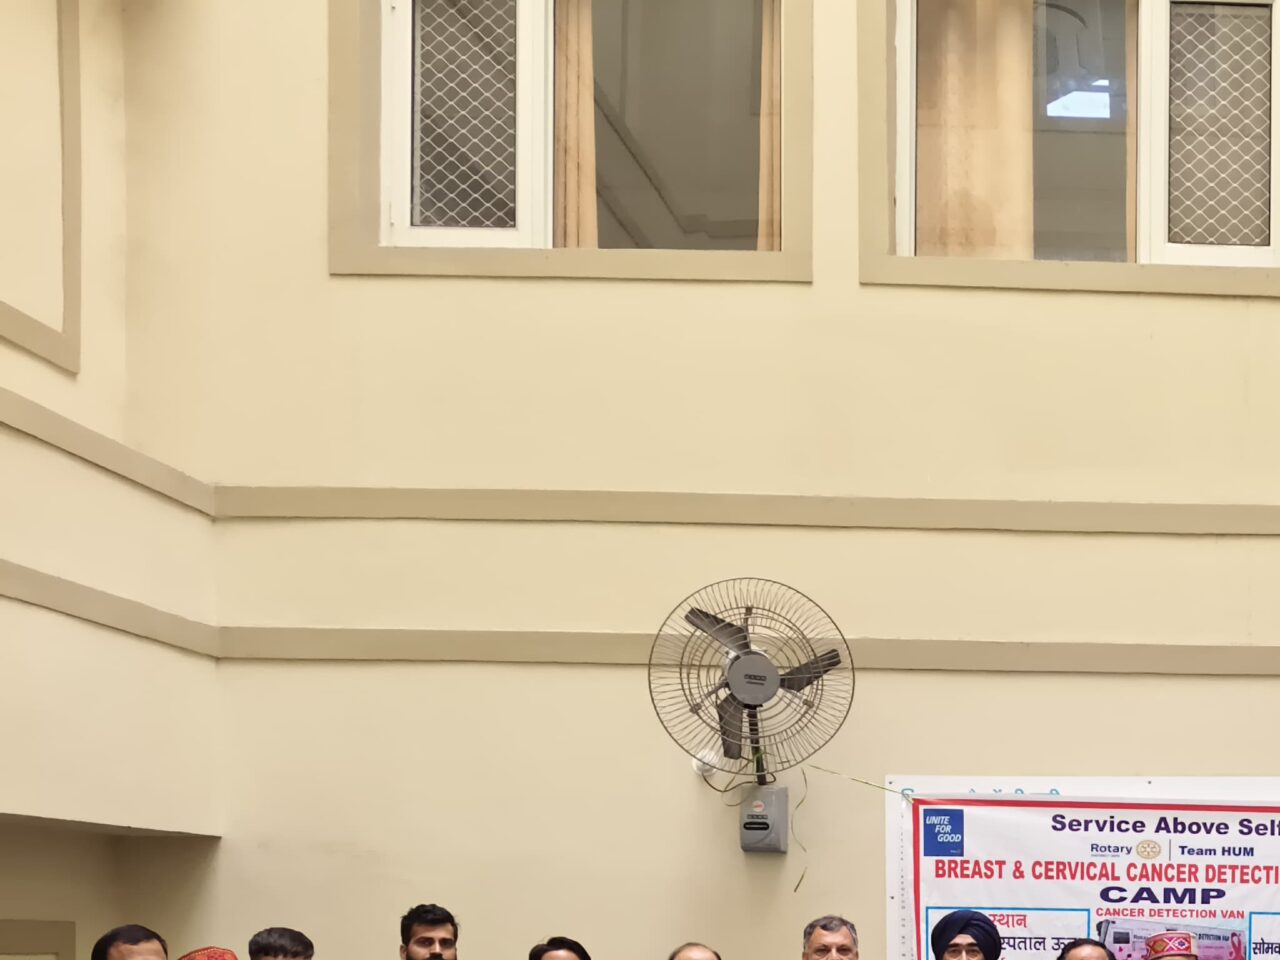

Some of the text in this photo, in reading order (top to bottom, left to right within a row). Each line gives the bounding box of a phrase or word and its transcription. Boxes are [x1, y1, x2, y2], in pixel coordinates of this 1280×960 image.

[925, 816, 950, 825] UNITE
[1051, 814, 1146, 833] Service
[1154, 816, 1230, 835] Above
[935, 825, 952, 833] FOR
[937, 833, 962, 843] GOOD
[1090, 843, 1255, 857] Rotary Team HUM
[935, 859, 1006, 880] BREAST
[1012, 860, 1025, 880] &
[1031, 860, 1120, 882] CERVICAL
[1126, 862, 1199, 883] CANCER
[1100, 886, 1226, 905] CAMP
[1096, 907, 1245, 919] CANCER DETECTION VAN
[1000, 936, 1046, 951] स्पताल
